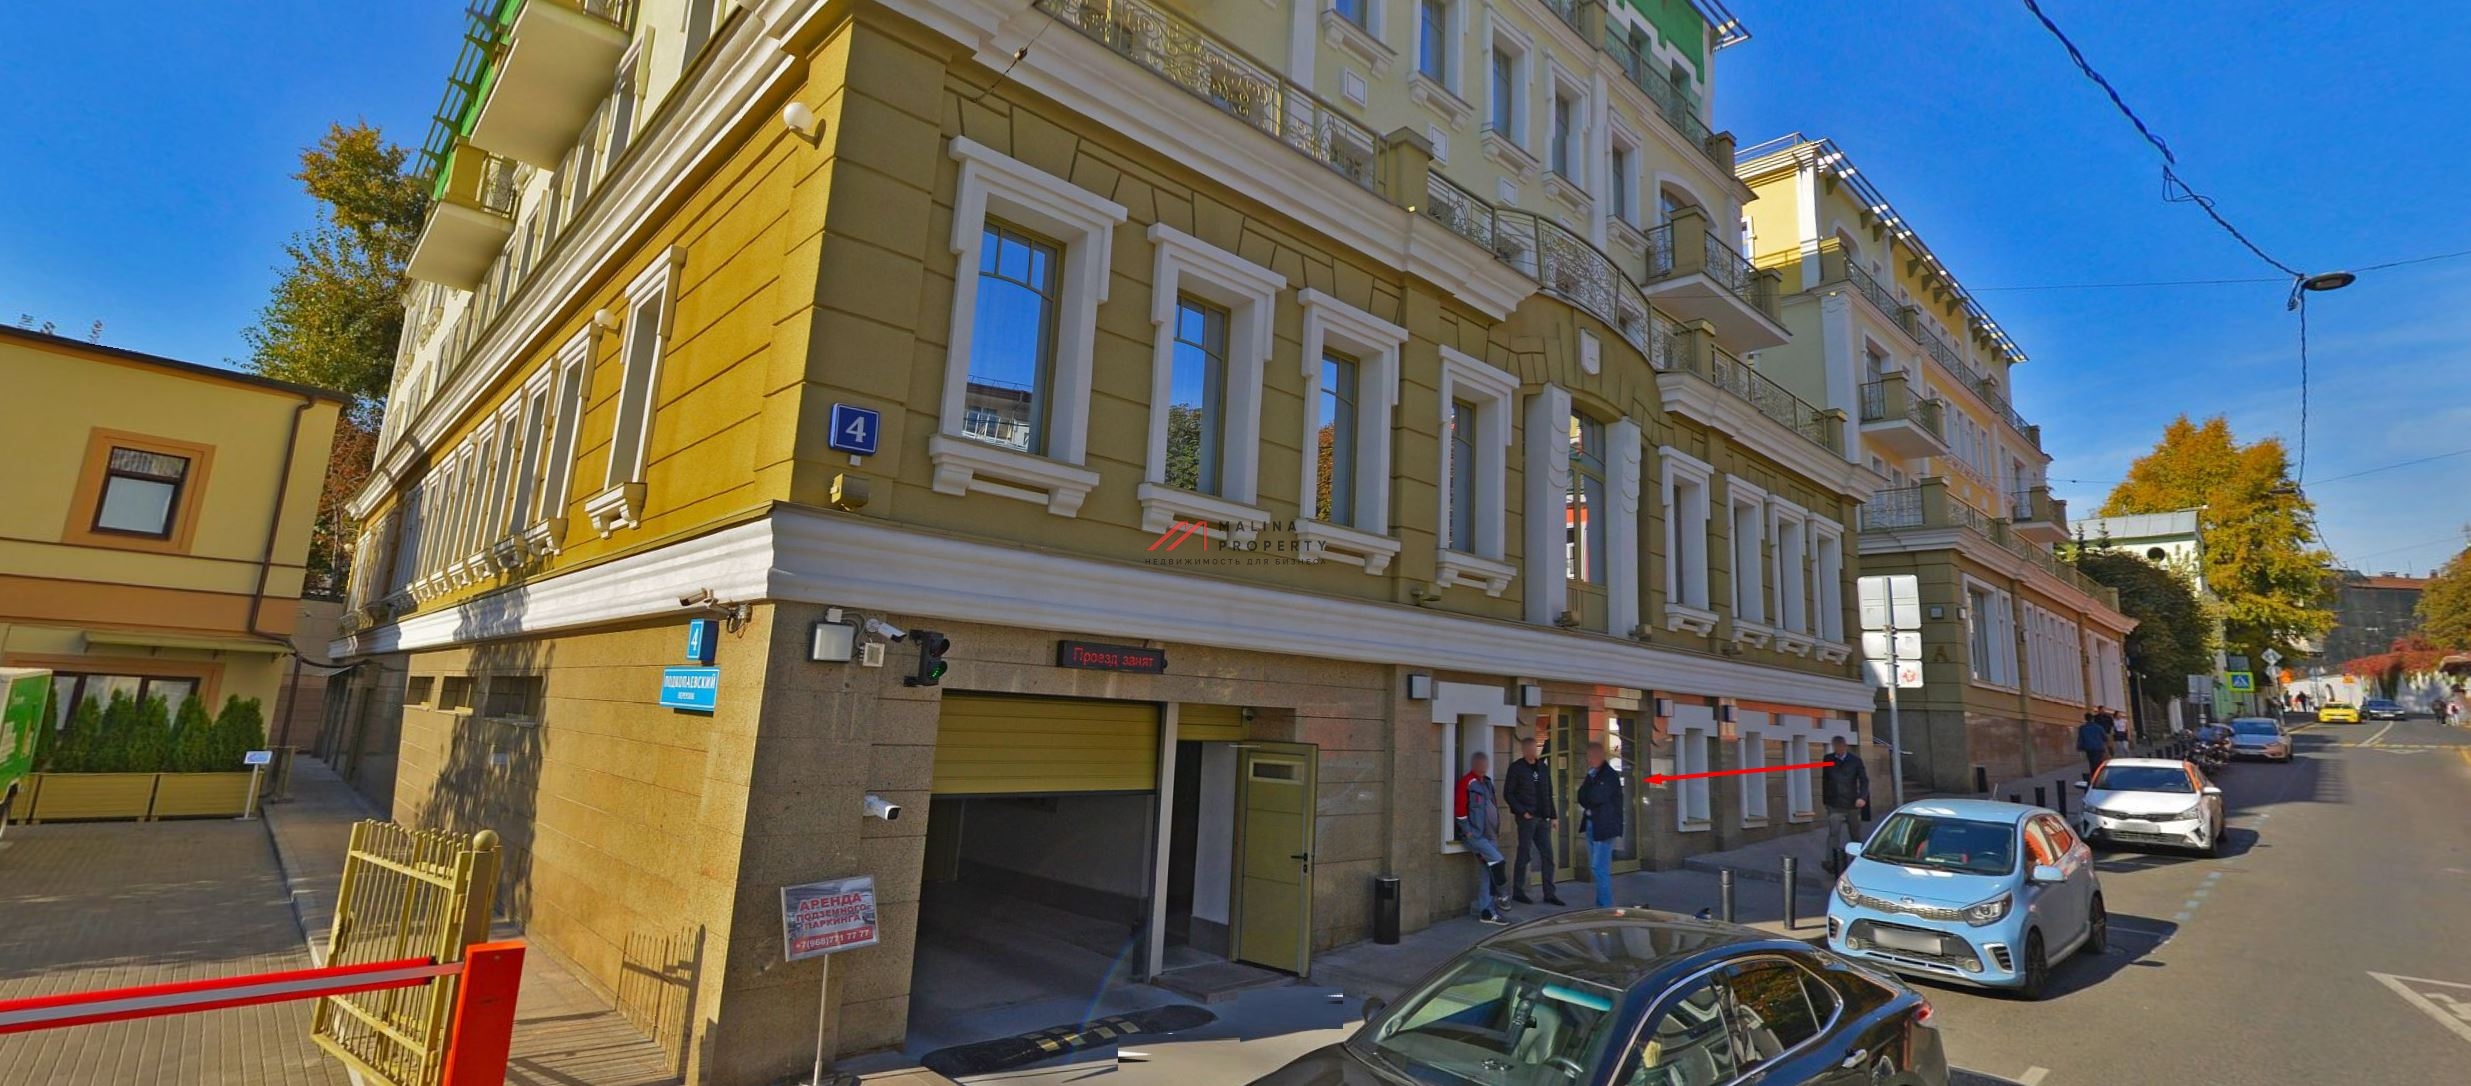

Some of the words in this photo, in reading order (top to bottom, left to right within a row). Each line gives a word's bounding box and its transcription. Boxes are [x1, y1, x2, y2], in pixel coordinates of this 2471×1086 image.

[846, 416, 866, 443] 4
[690, 628, 700, 651] 4
[1073, 647, 1118, 667] Проезд
[1122, 655, 1154, 668] занят
[800, 892, 862, 911] АРЕНДА
[796, 904, 866, 922] ПОДЗЕМНОГО
[806, 914, 860, 930] ПАРКИНГА
